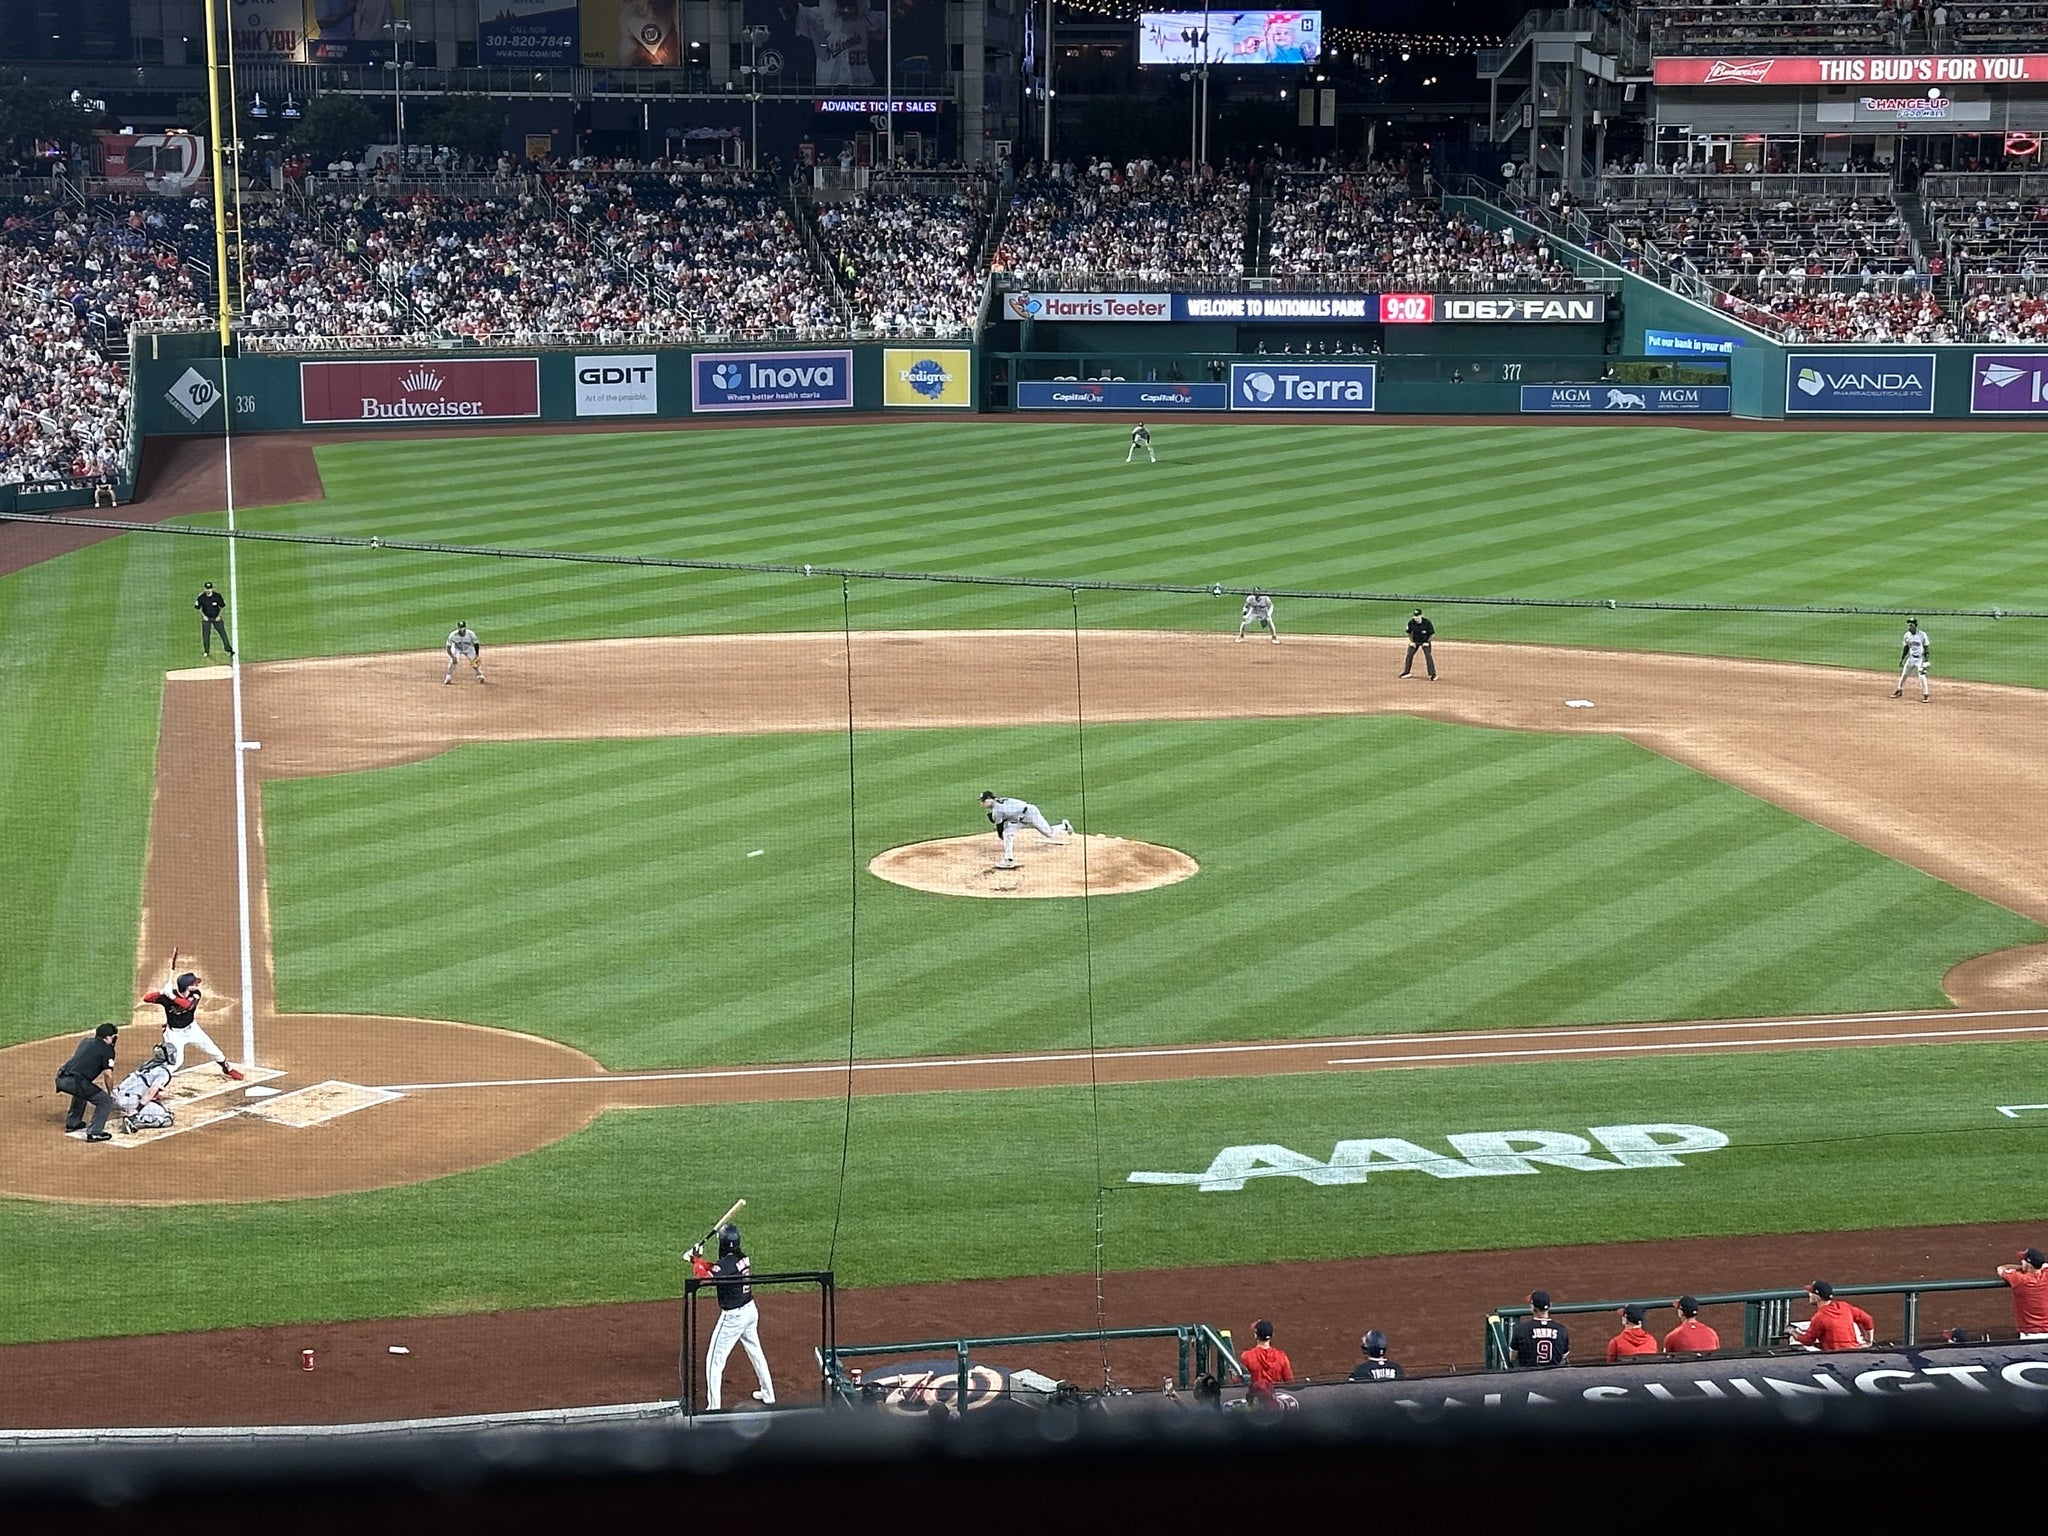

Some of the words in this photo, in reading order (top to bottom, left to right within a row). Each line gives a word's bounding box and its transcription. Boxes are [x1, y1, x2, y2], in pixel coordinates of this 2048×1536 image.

[266, 30, 297, 51] YOU
[1712, 65, 1765, 77] Budweiser
[1819, 59, 1865, 80] THIS
[1870, 59, 1932, 80] BUD'S
[1936, 58, 1977, 80] FOR
[1982, 58, 2029, 79] YOU.
[821, 101, 867, 112] ADVANCE
[905, 102, 937, 112] SALES
[1866, 98, 1950, 110] CHANGE-UP
[1046, 298, 1102, 316] Harris
[1103, 299, 1166, 316] Teeter
[1187, 298, 1245, 316] WELCOME
[1246, 299, 1263, 316] TO
[1264, 299, 1331, 316] NATIONALS
[1332, 299, 1365, 316] PARK
[1387, 298, 1425, 319] 9:02
[1443, 300, 1516, 319] 106.7
[1523, 300, 1593, 319] FAN
[1648, 336, 1661, 346] Put
[1661, 338, 1674, 347] our
[1674, 337, 1692, 349] bank
[1693, 338, 1701, 350] in
[1701, 342, 1719, 354] your
[1719, 342, 1736, 353] offi
[579, 367, 654, 385] GDIT
[749, 362, 834, 389] Inova
[900, 369, 953, 385] Pedigree
[1502, 363, 1521, 381] 377
[1826, 373, 1923, 389] VANDA
[727, 393, 751, 401] Where
[752, 393, 775, 401] better
[775, 392, 798, 400] health
[800, 391, 821, 399] starts
[1278, 374, 1363, 401] Terra
[1551, 389, 1591, 401] MGM
[1658, 389, 1698, 401] MGM
[235, 395, 255, 413] 336
[361, 398, 481, 418] Budweiser
[1127, 1123, 1730, 1193] AARP
[1537, 1340, 1553, 1363] 9
